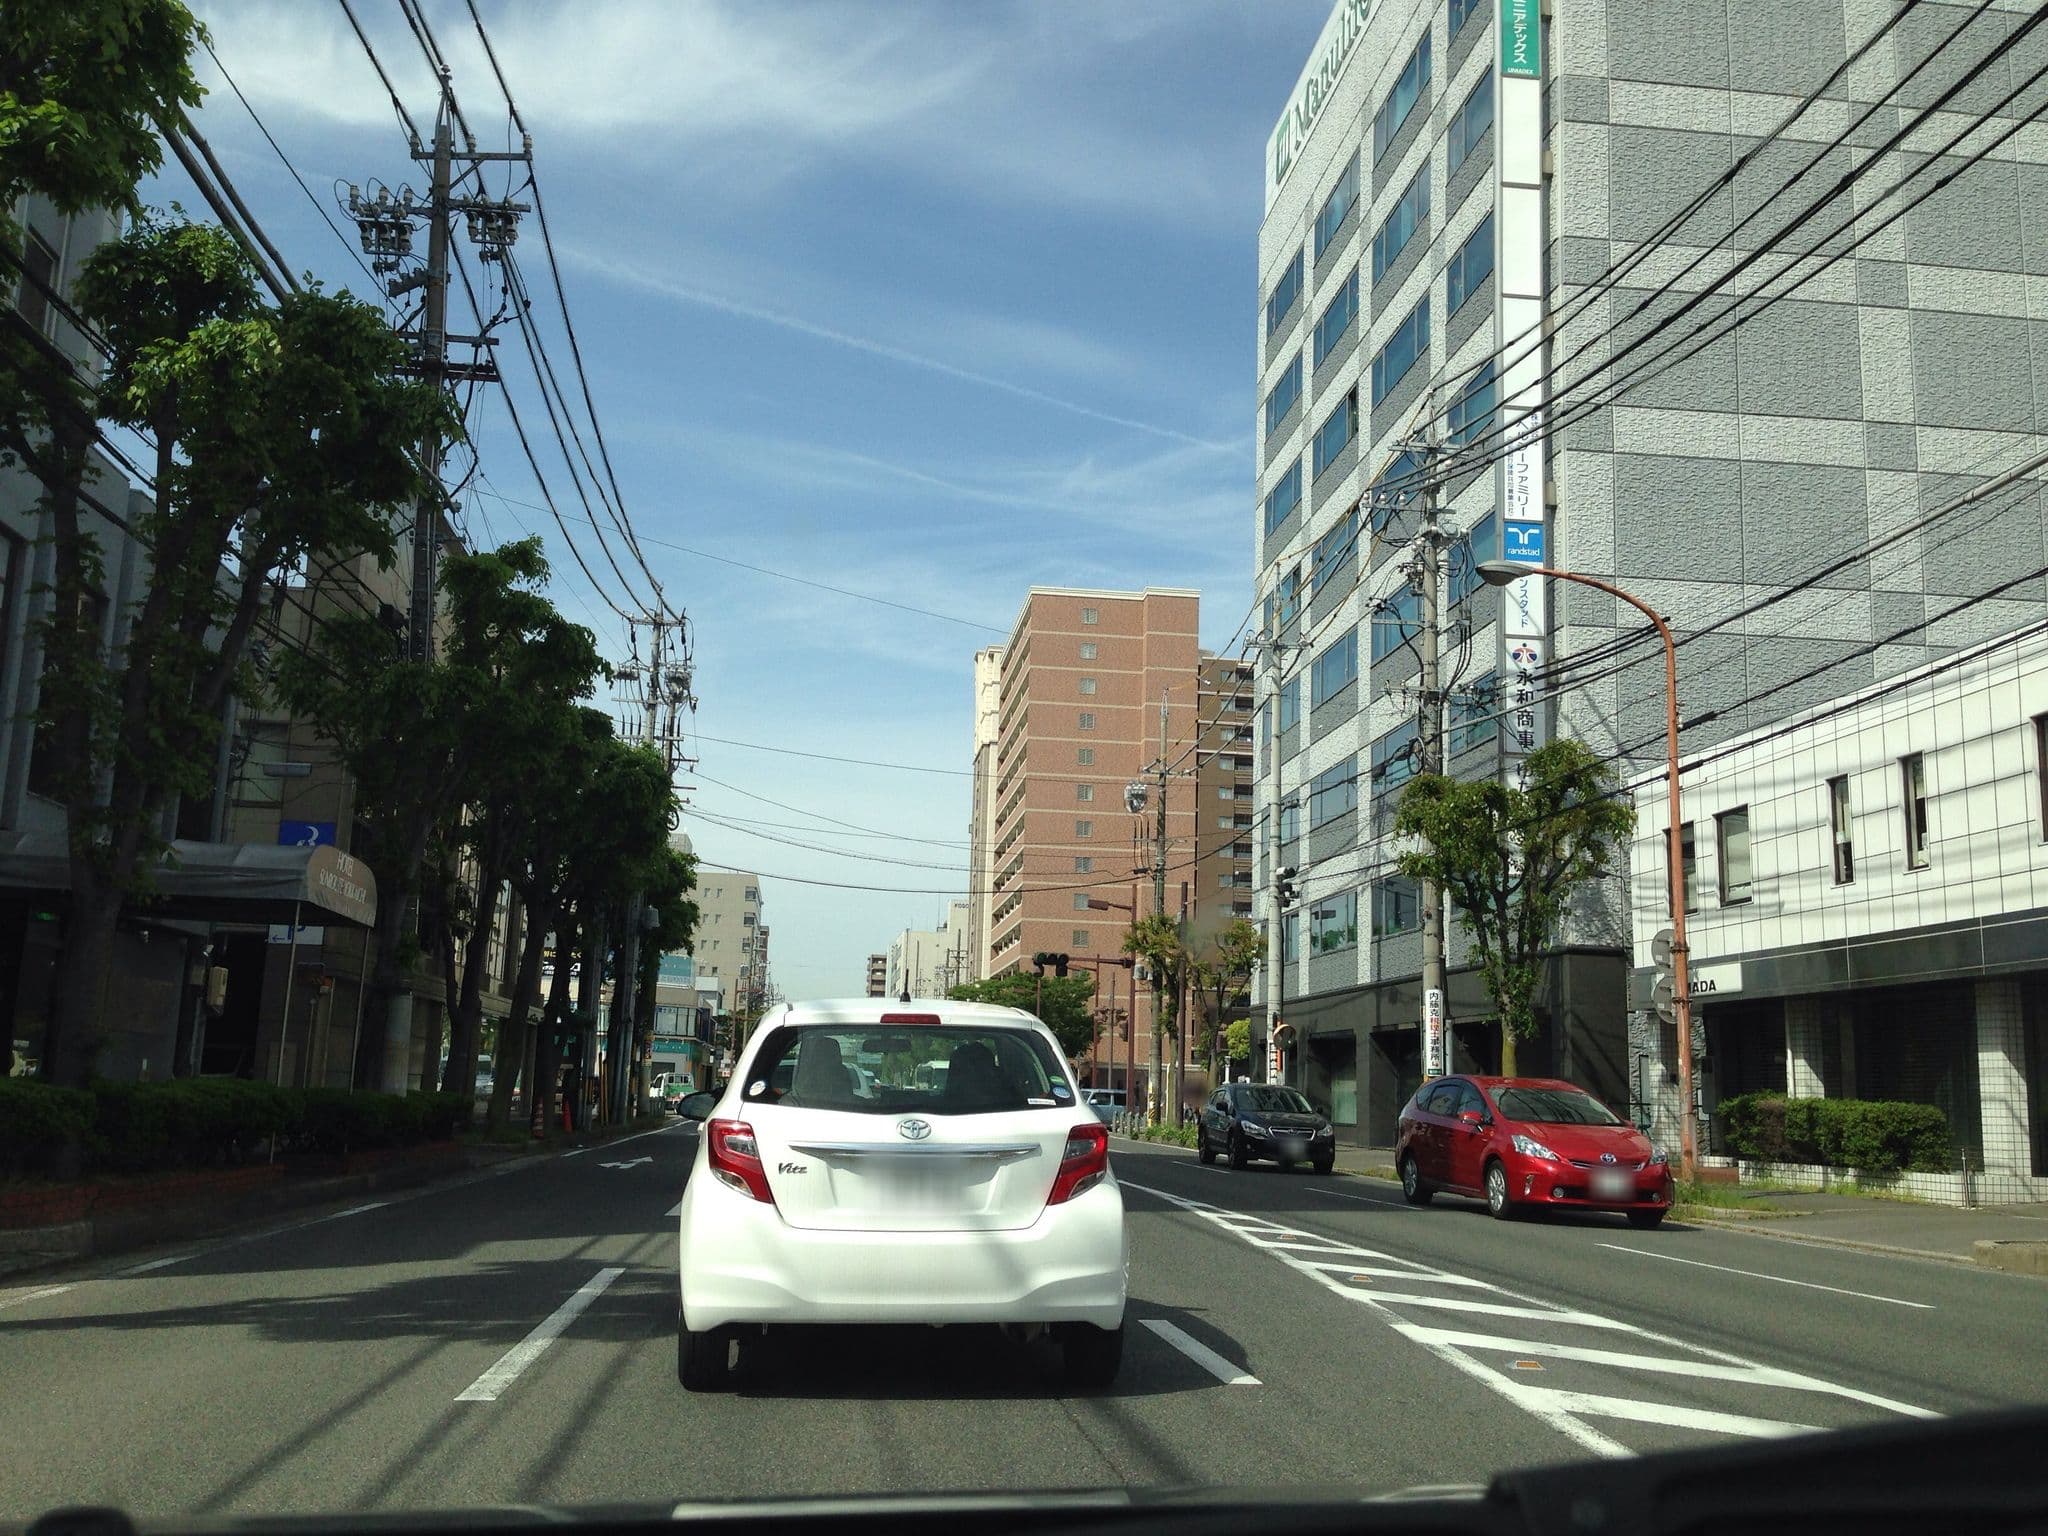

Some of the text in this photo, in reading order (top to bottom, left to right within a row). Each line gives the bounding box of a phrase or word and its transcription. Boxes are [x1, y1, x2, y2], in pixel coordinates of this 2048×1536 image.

[1507, 547, 1540, 557] randstad
[1516, 668, 1535, 748] 永和商事
[778, 1162, 808, 1175] Vitz
